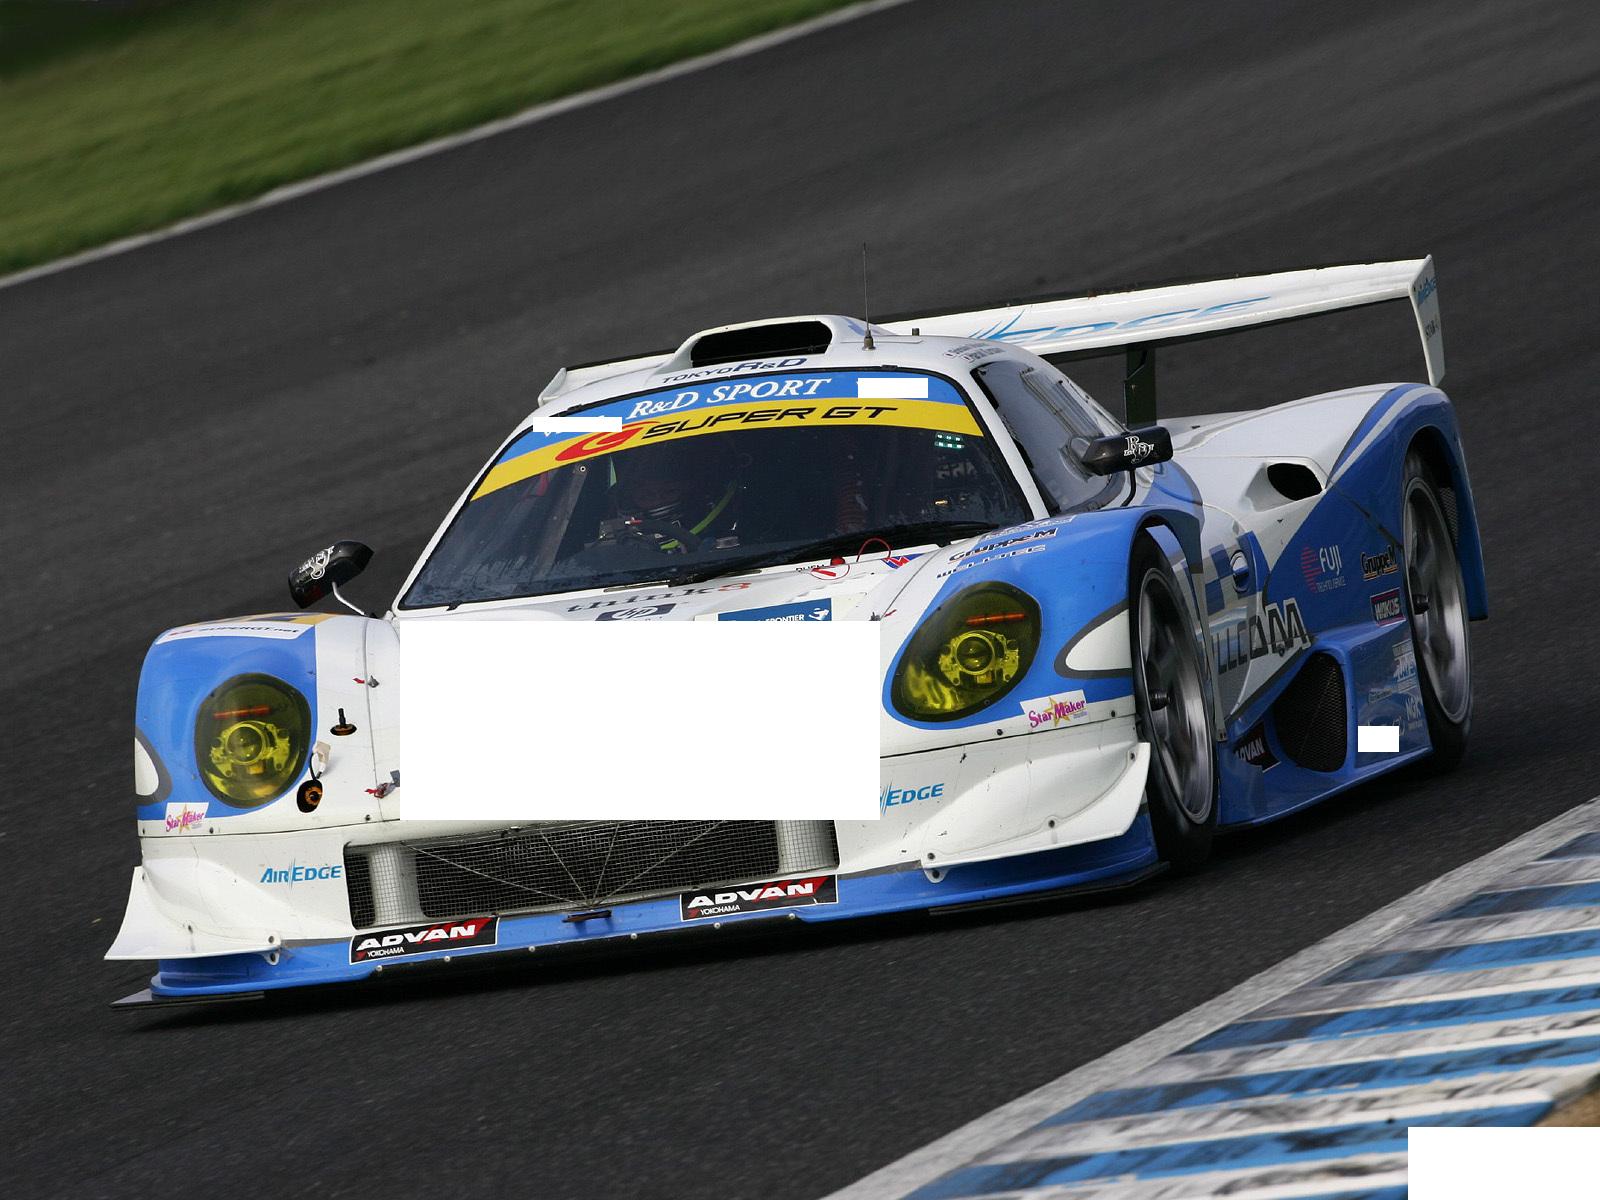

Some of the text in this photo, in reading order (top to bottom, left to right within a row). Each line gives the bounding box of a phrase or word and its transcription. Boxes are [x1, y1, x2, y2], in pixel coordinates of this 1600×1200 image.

[662, 367, 734, 384] TOKYO
[625, 377, 832, 420] R&D SPORT
[641, 406, 817, 440] SUPER
[820, 406, 899, 419] GT
[1319, 544, 1343, 577] FUJI
[885, 782, 945, 807] EDGE
[687, 882, 814, 909] ADVAN
[700, 904, 741, 916] YOKOHAMA
[355, 924, 476, 952] ADVAN
[367, 947, 405, 958] YOKOHAMA
